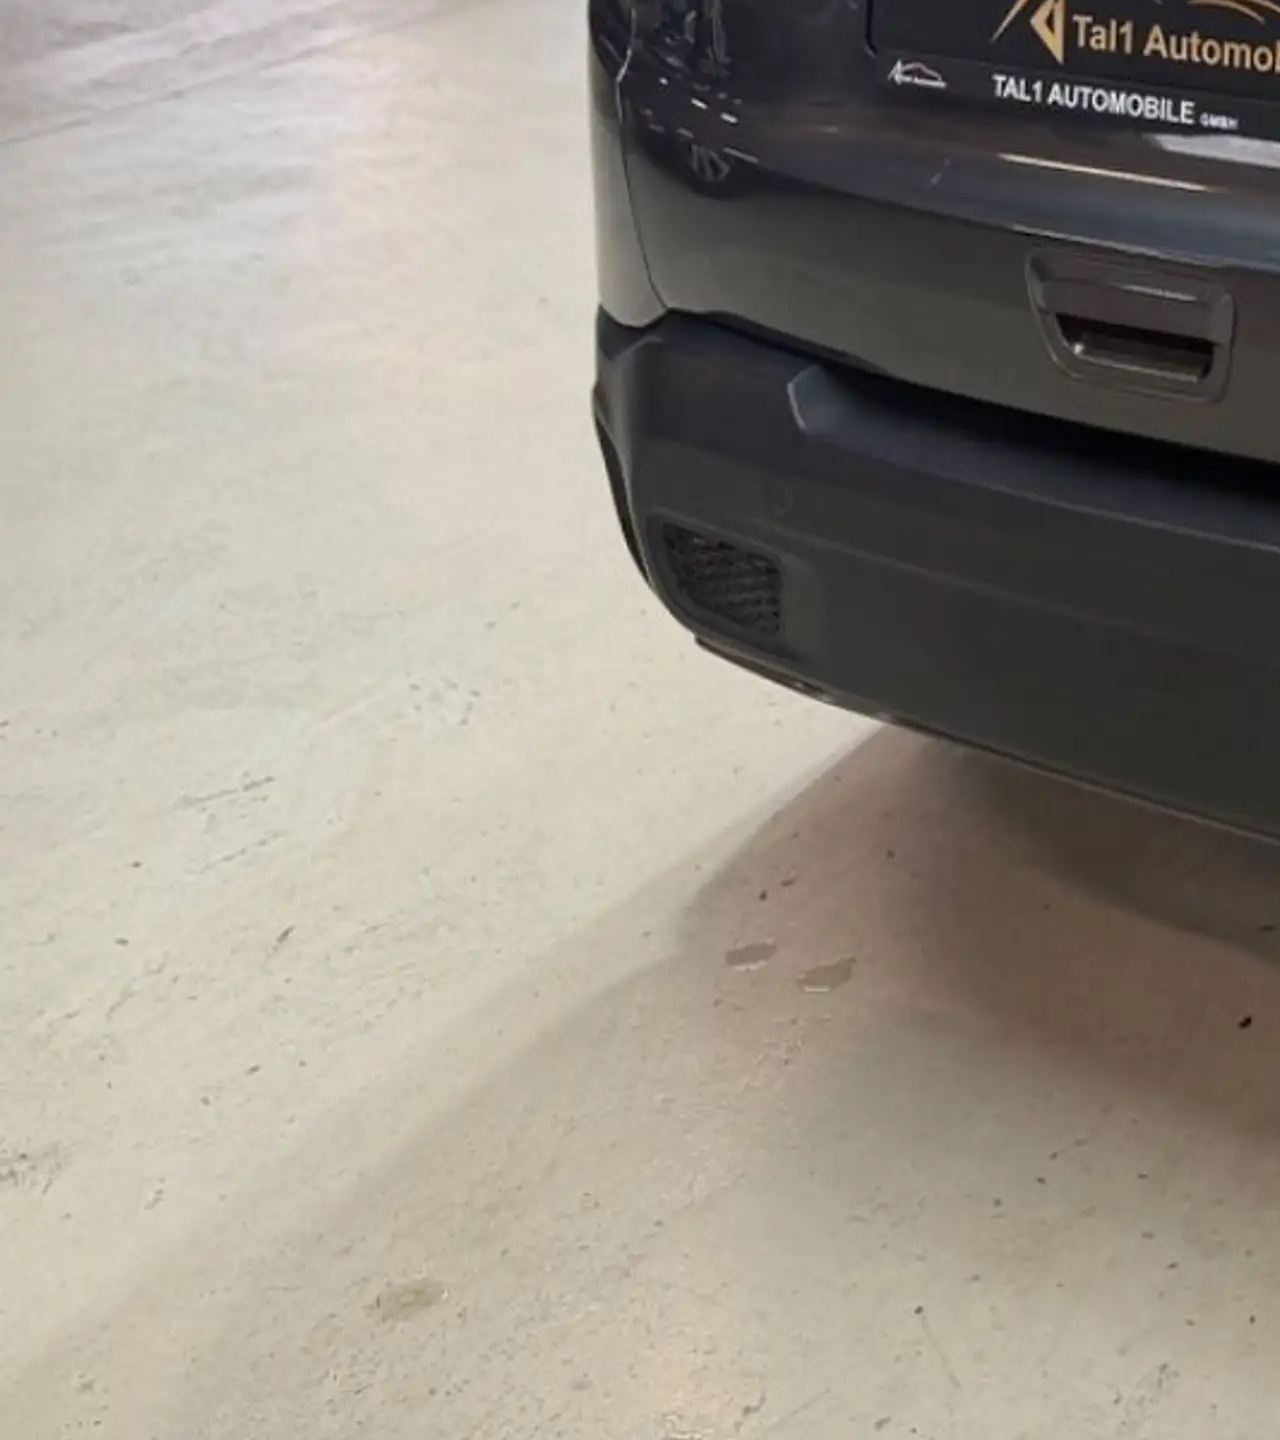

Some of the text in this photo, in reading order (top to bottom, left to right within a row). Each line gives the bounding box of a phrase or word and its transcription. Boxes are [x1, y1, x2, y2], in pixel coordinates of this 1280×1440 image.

[1072, 13, 1134, 55] Tal1
[991, 73, 1044, 103] TAL1
[1046, 82, 1196, 125] AUTOMOBILE
